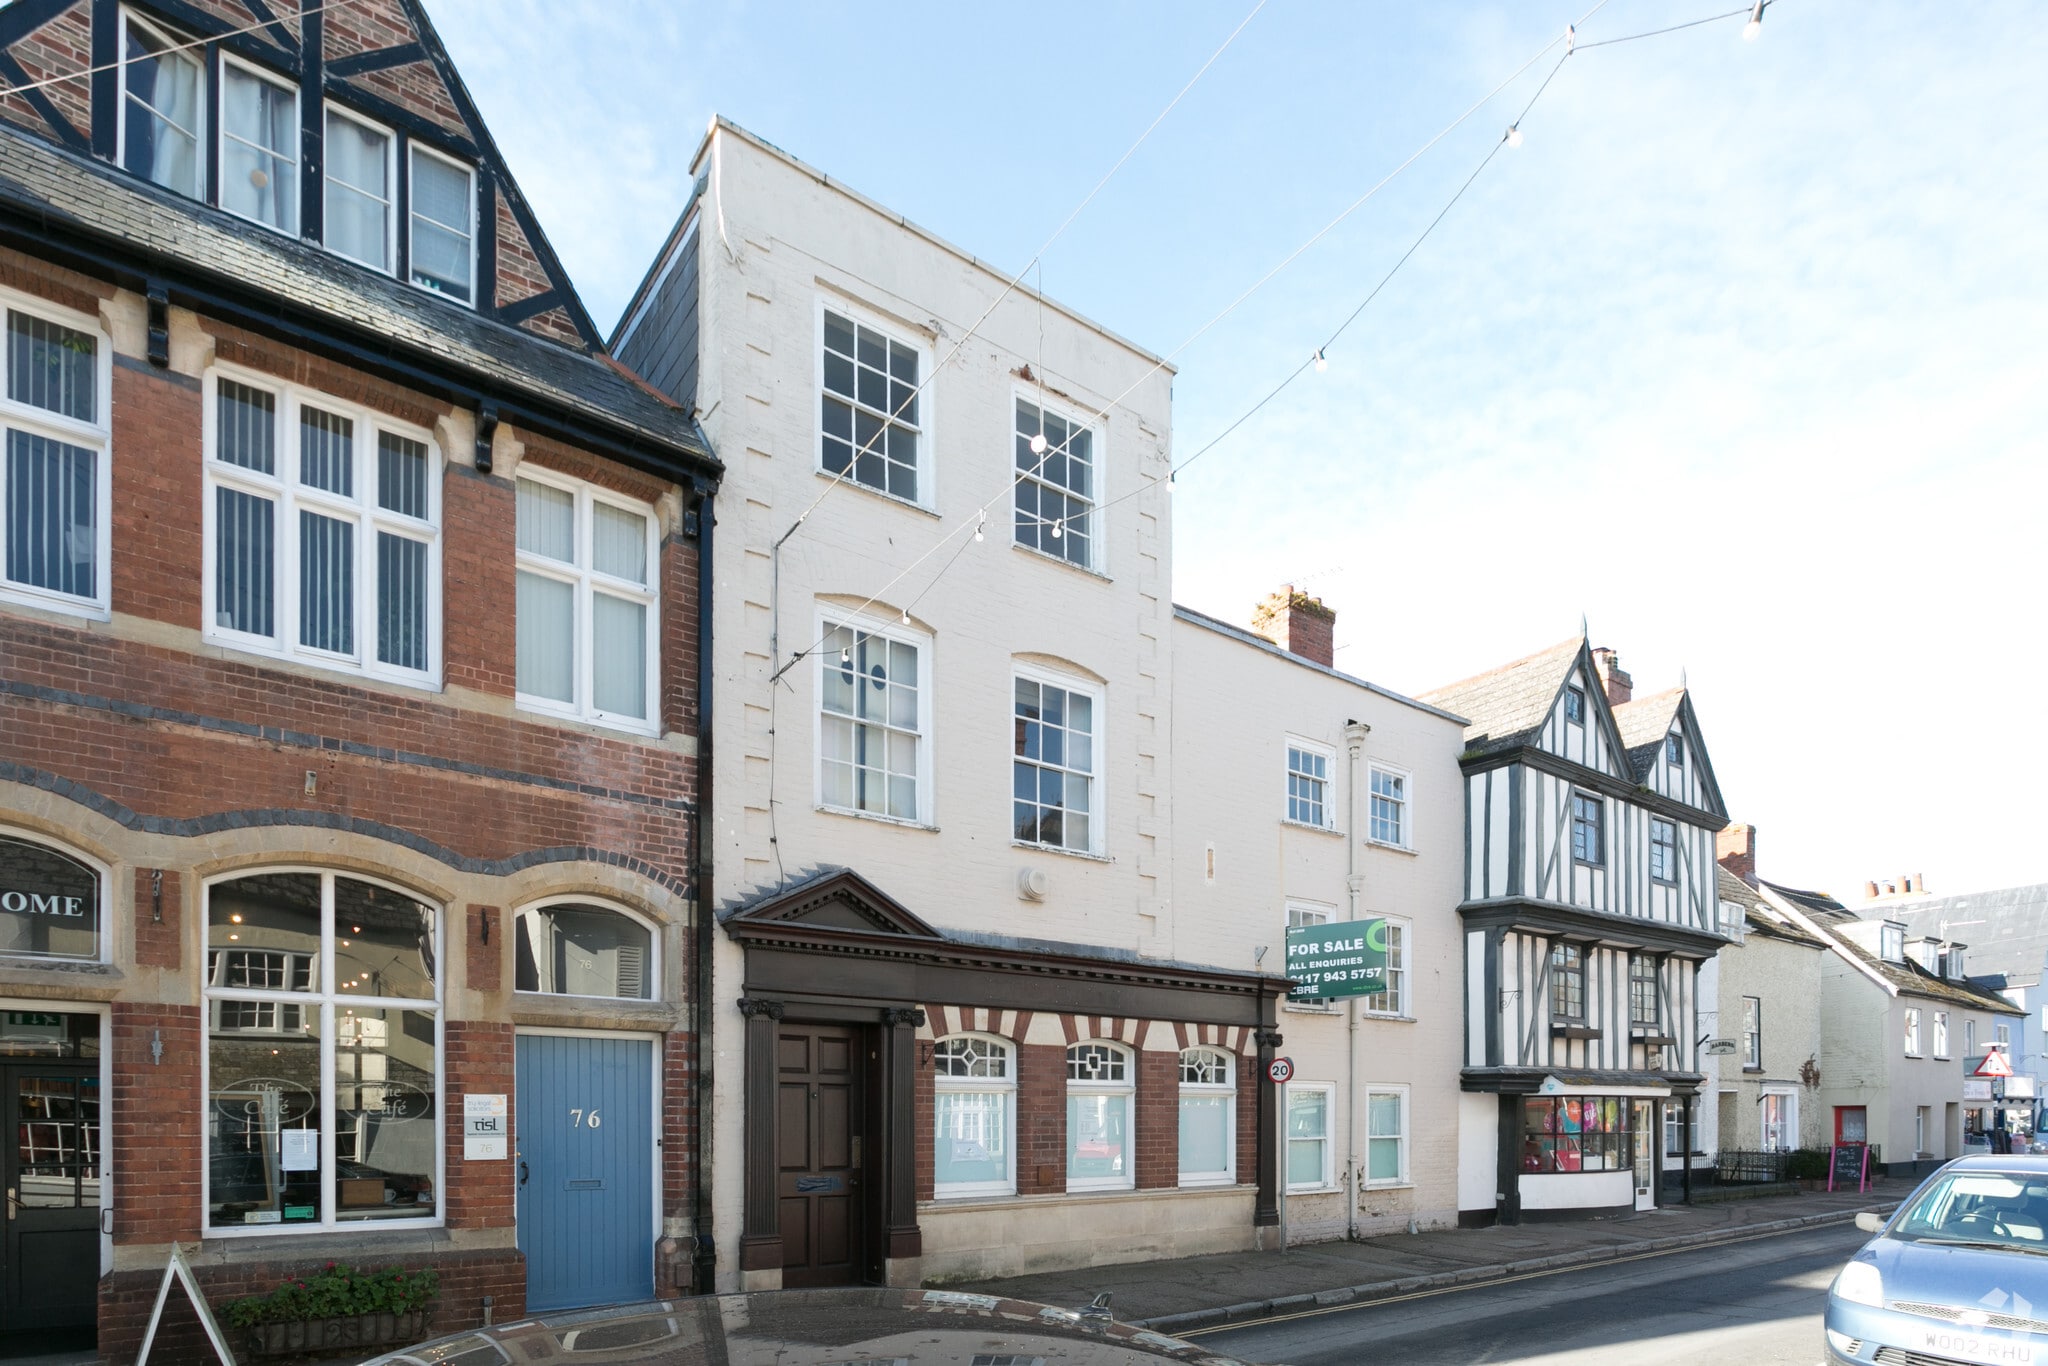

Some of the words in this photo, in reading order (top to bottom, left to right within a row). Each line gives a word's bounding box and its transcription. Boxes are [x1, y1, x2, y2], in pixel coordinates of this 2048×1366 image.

[1, 891, 84, 917] OME
[1289, 943, 1319, 956] FOR
[1324, 938, 1364, 953] SALE
[579, 959, 593, 970] 76
[1289, 962, 1307, 970] ALL
[1309, 956, 1363, 968] ENQUIRIES
[1324, 971, 1347, 982] 943
[1351, 967, 1382, 979] 5757
[1272, 1065, 1289, 1076] 20
[570, 1108, 601, 1128] 76
[1987, 1342, 2031, 1362] RHU
